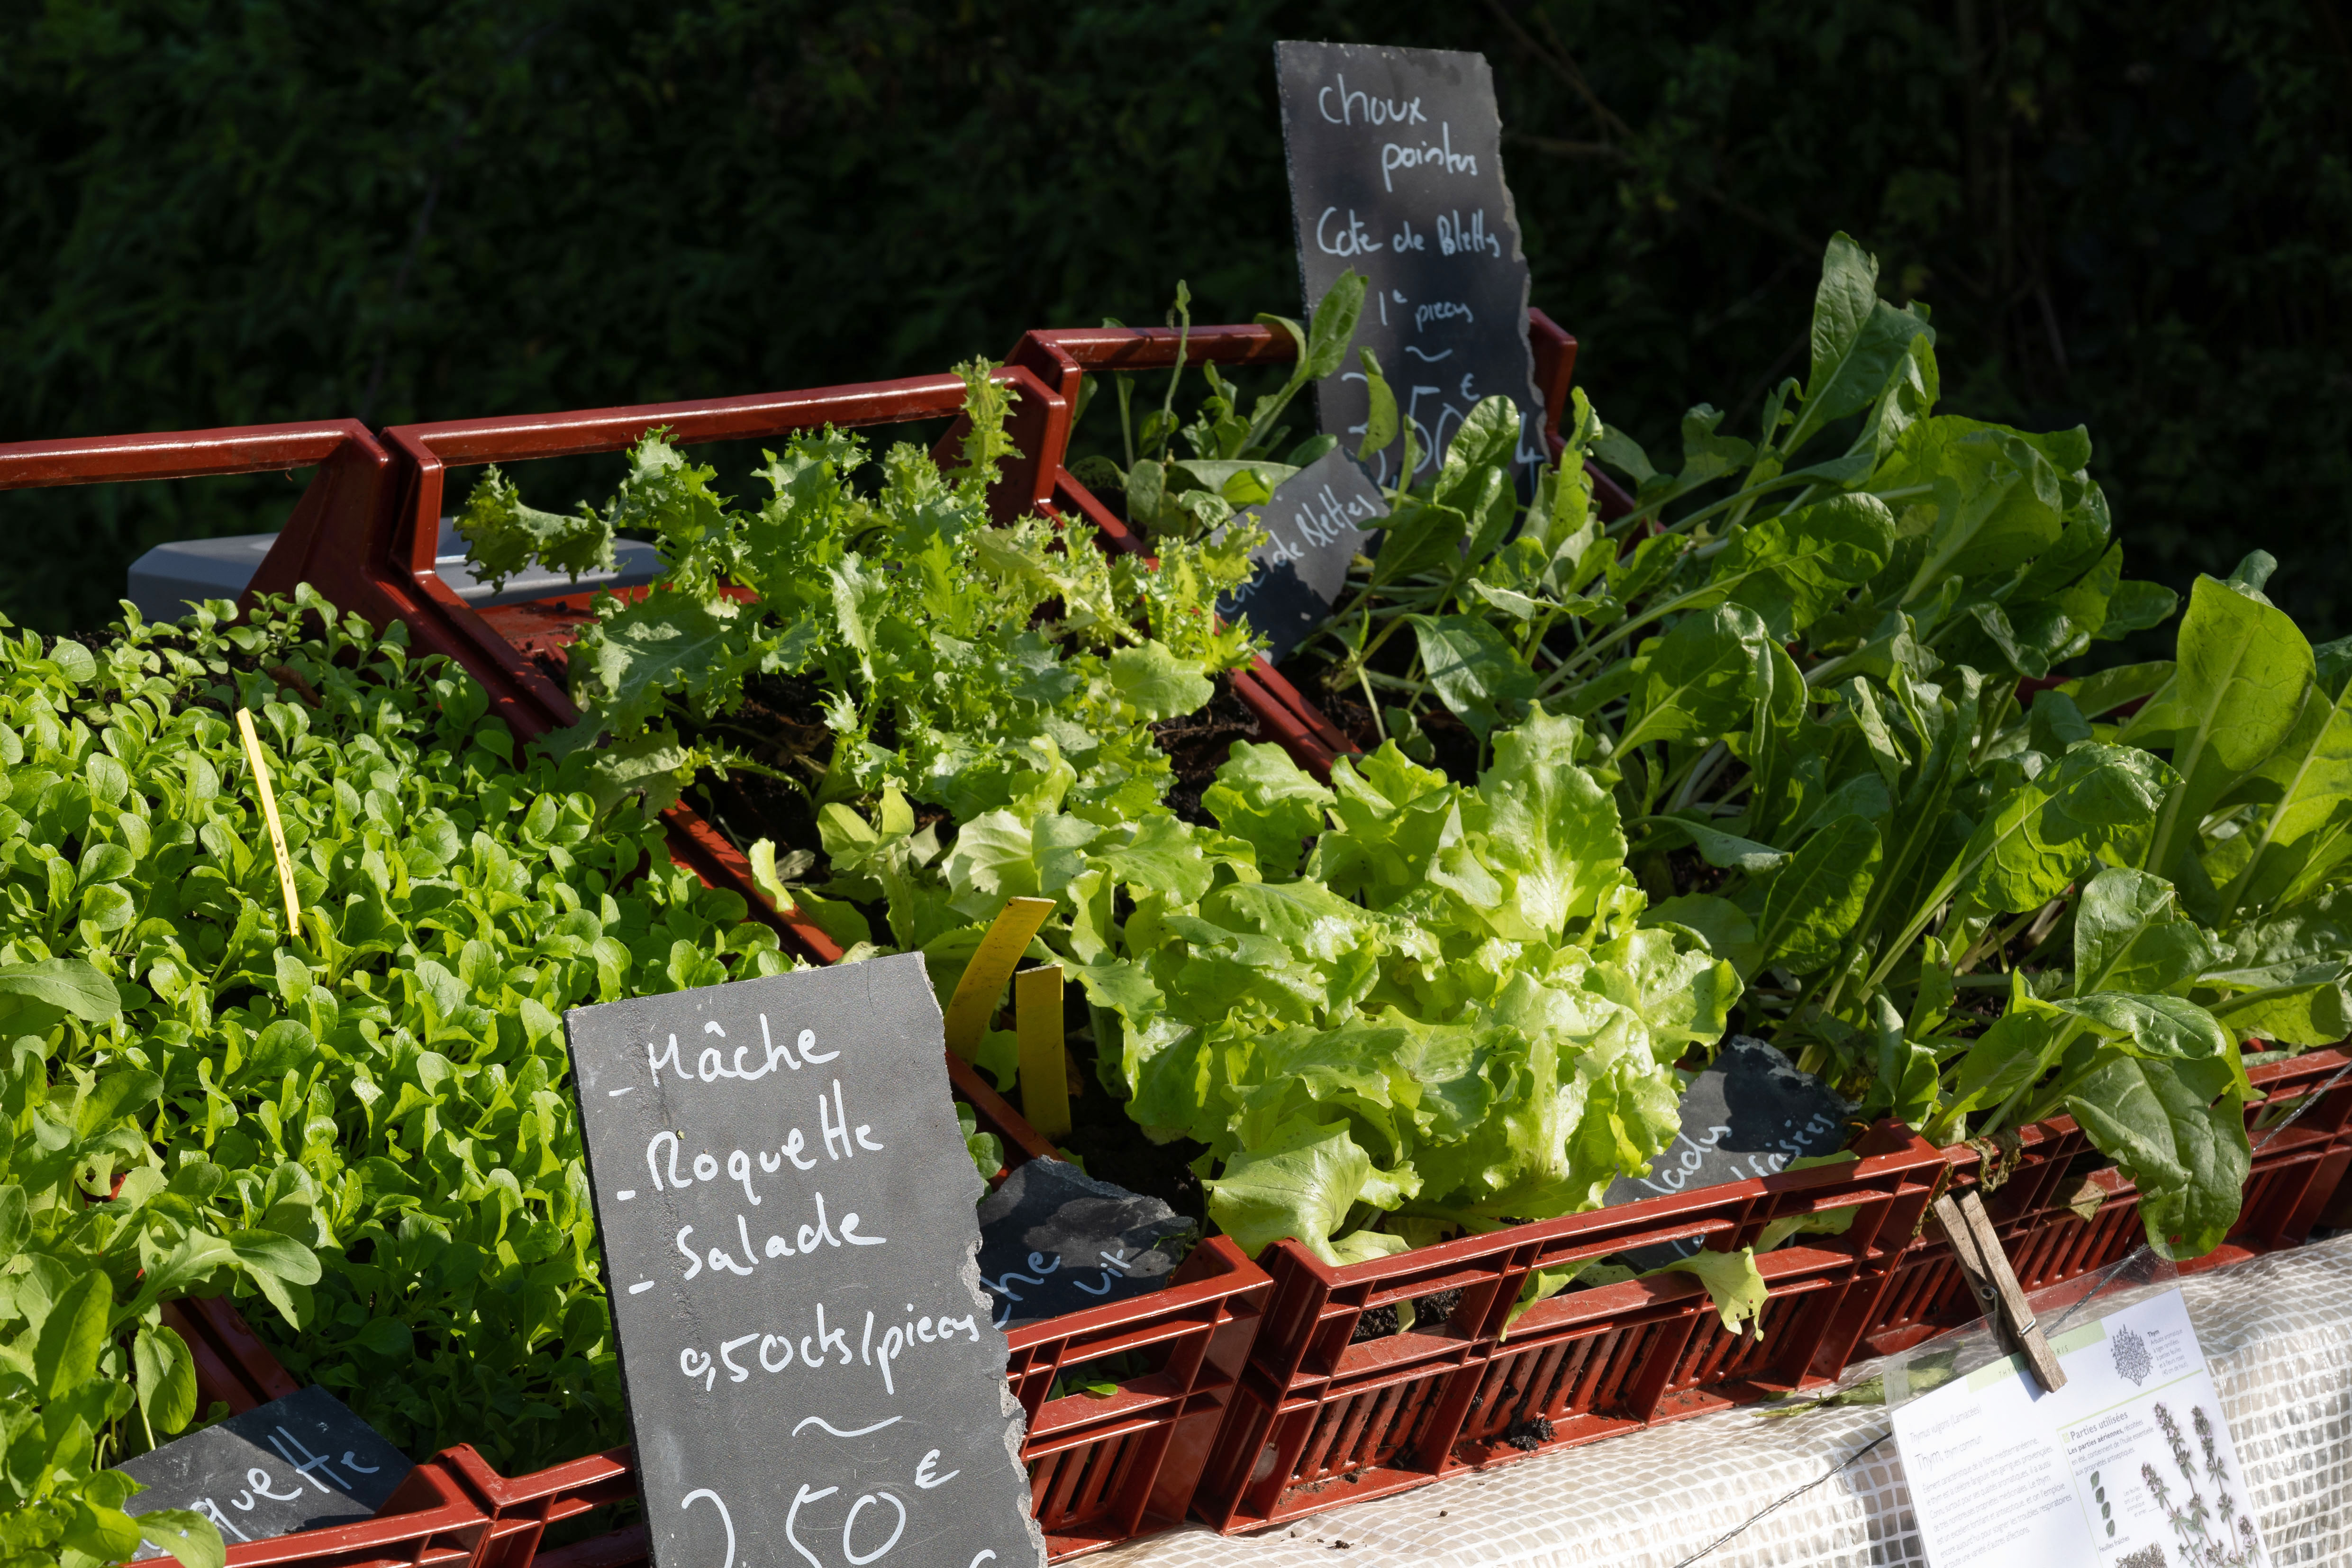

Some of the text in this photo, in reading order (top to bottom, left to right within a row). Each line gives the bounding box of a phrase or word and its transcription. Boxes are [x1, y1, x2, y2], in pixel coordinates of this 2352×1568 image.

[1392, 221, 1425, 253] de
[1269, 529, 1304, 567] de
[647, 1013, 841, 1088] Mâche
[646, 1079, 884, 1205] Roquette
[2070, 1412, 2128, 1440] Parties utilisées
[2078, 1440, 2096, 1452] parties
[2098, 1429, 2124, 1442] aériennes,
[2124, 1420, 2143, 1431] récoltées
[2028, 1480, 2036, 1488] Le
[2036, 1475, 2051, 1486] thym
[2017, 1509, 2038, 1522] troubles
[2040, 1495, 2072, 1513] respiratoires
[2026, 1495, 2032, 1504] et
[2098, 1536, 2130, 1552] Feuilles fraîches
